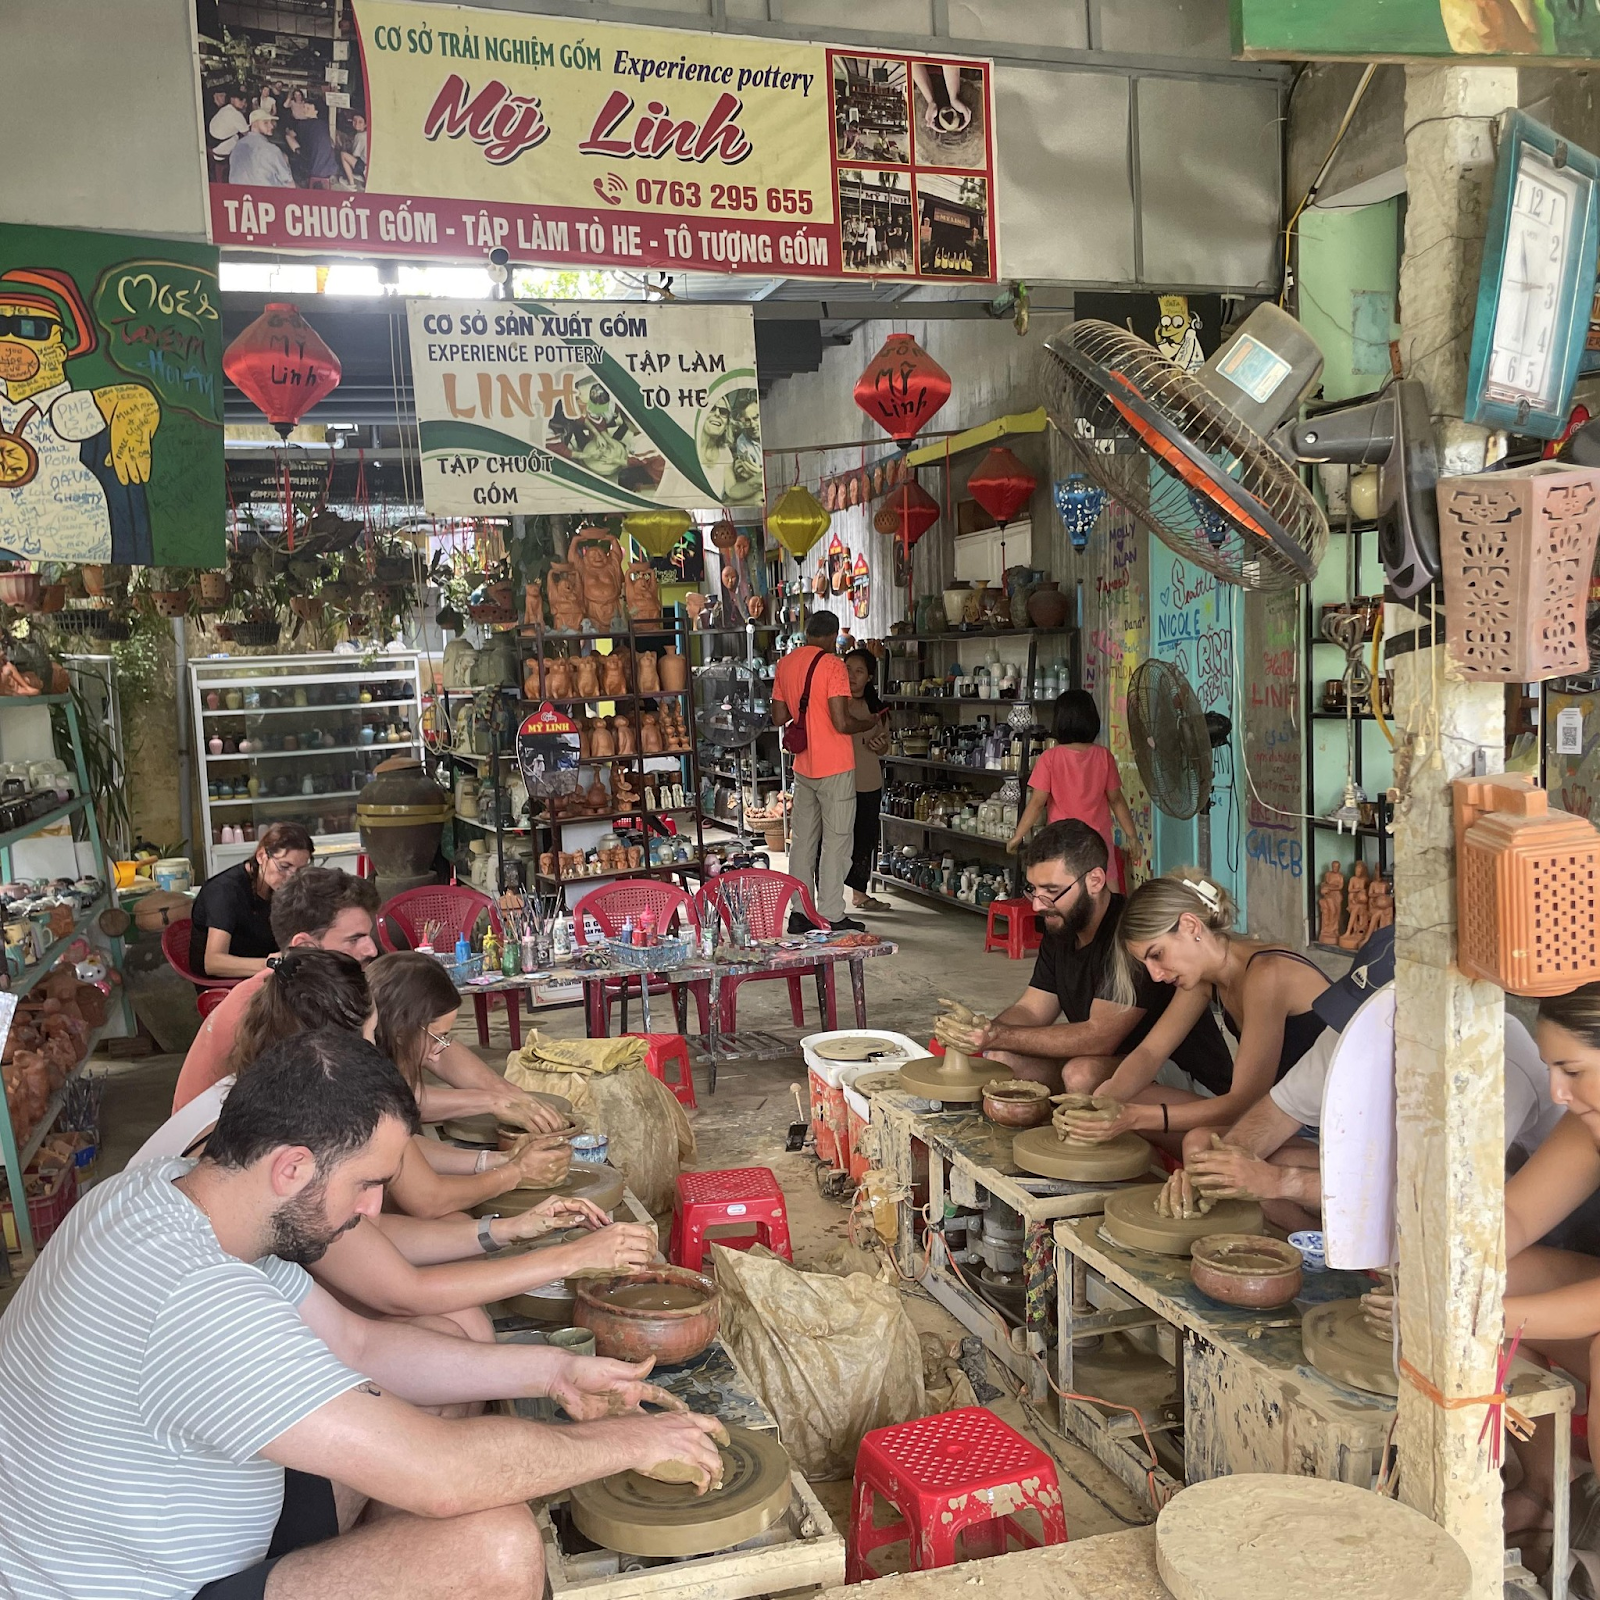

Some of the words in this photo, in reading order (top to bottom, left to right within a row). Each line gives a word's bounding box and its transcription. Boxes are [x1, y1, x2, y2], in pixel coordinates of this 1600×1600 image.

[374, 25, 401, 52] CƠ
[406, 22, 432, 55] SỞ
[438, 26, 479, 59] TRẢI
[485, 38, 554, 71] NGHIỆM
[559, 38, 601, 72] GỐM
[613, 49, 733, 85] Experience
[737, 64, 813, 96] pottery
[424, 74, 550, 165] Mỹ
[579, 90, 753, 165] Linh
[636, 178, 701, 208] 0763
[711, 184, 758, 211] 295
[766, 187, 813, 215] 655
[1528, 186, 1544, 218] 12
[223, 195, 275, 240] TẬP
[285, 197, 370, 239] CHUỐT
[378, 200, 438, 243] GỐM
[462, 209, 508, 253] TẬP
[517, 213, 569, 252] LÀM
[576, 217, 604, 255] TÒ
[613, 228, 642, 256] HE
[664, 222, 694, 259] TÔ
[698, 228, 773, 269] TƯỢNG
[780, 226, 829, 266] GỐM
[1550, 235, 1560, 263] 2
[1544, 282, 1554, 310] 3
[423, 314, 453, 335] CƠ
[460, 310, 489, 336] SỞ
[495, 311, 533, 336] SẢN
[541, 311, 592, 337] XUẤT
[600, 311, 647, 337] GỐM
[428, 344, 527, 362] EXPERIENCE
[534, 346, 604, 363] POTTERY
[1537, 326, 1547, 353] 4
[272, 365, 317, 386] Linh
[625, 352, 671, 376] TẬP
[678, 350, 726, 373] LÀM
[1507, 356, 1517, 383] 6
[1525, 361, 1535, 389] 5
[442, 373, 577, 419] LINH
[643, 385, 671, 408] TÒ
[678, 388, 708, 408] HE
[438, 456, 479, 475] TẬP
[486, 449, 554, 474] CHUỐT
[473, 481, 519, 505] GỐM
[1110, 521, 1136, 543] MOLLY
[1113, 547, 1138, 571] ALAN
[1159, 609, 1200, 638] NICOLE
[546, 723, 569, 731] LINH
[1246, 829, 1302, 878] CALEB
